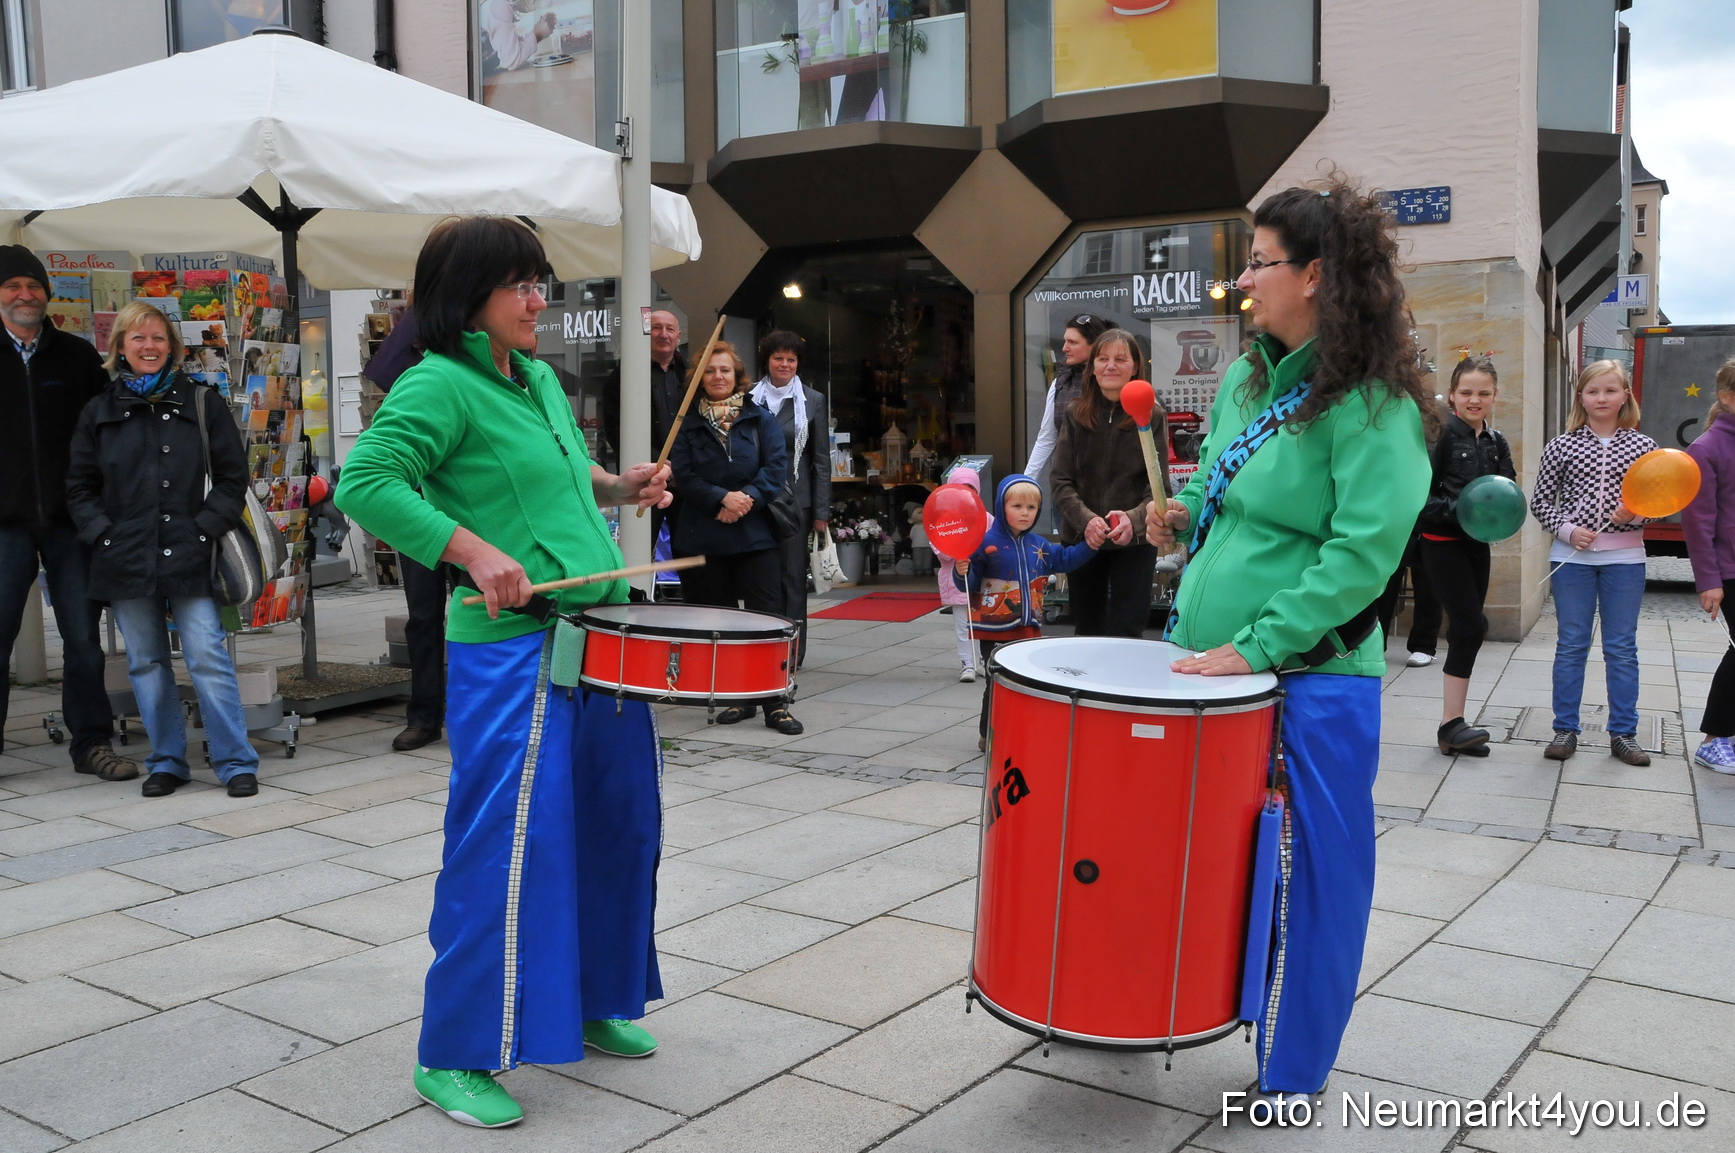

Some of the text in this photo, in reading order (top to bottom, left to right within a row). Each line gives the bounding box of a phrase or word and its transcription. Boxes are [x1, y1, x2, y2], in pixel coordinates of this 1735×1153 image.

[1400, 196, 1407, 205] S
[1425, 194, 1432, 203] S
[46, 252, 115, 269] Papelino
[155, 255, 219, 271] Kultura
[236, 255, 273, 276] Kultura
[1034, 288, 1110, 302] Willkommen
[1113, 286, 1129, 297] im
[1133, 270, 1202, 306] RACKL
[1625, 280, 1639, 298] M
[1133, 306, 1155, 314] Jeden
[1155, 305, 1168, 313] Tag
[550, 322, 561, 331] im
[563, 309, 612, 339] RACKL
[1188, 377, 1219, 386] Original
